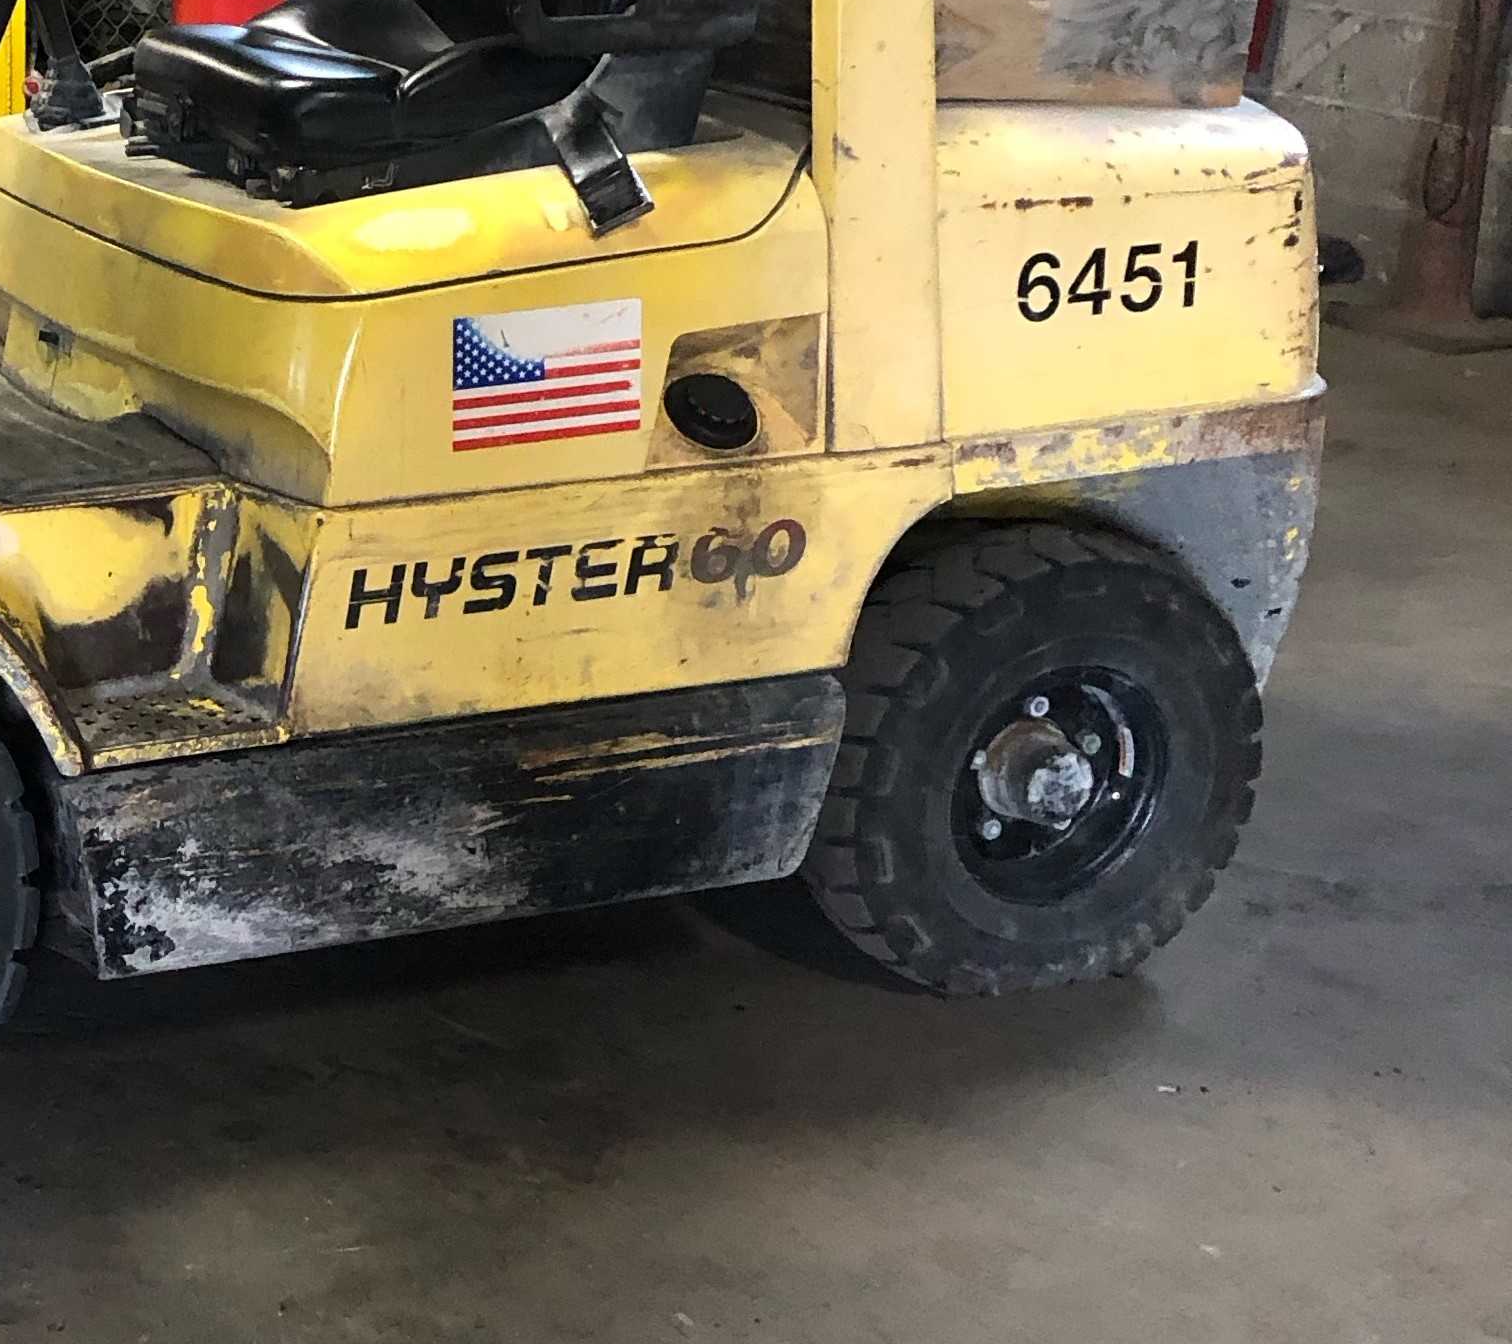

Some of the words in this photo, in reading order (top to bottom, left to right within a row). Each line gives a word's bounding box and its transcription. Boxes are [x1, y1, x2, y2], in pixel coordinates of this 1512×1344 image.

[1017, 240, 1198, 323] 6451
[345, 532, 681, 630] HYSTER
[690, 518, 807, 584] 60
